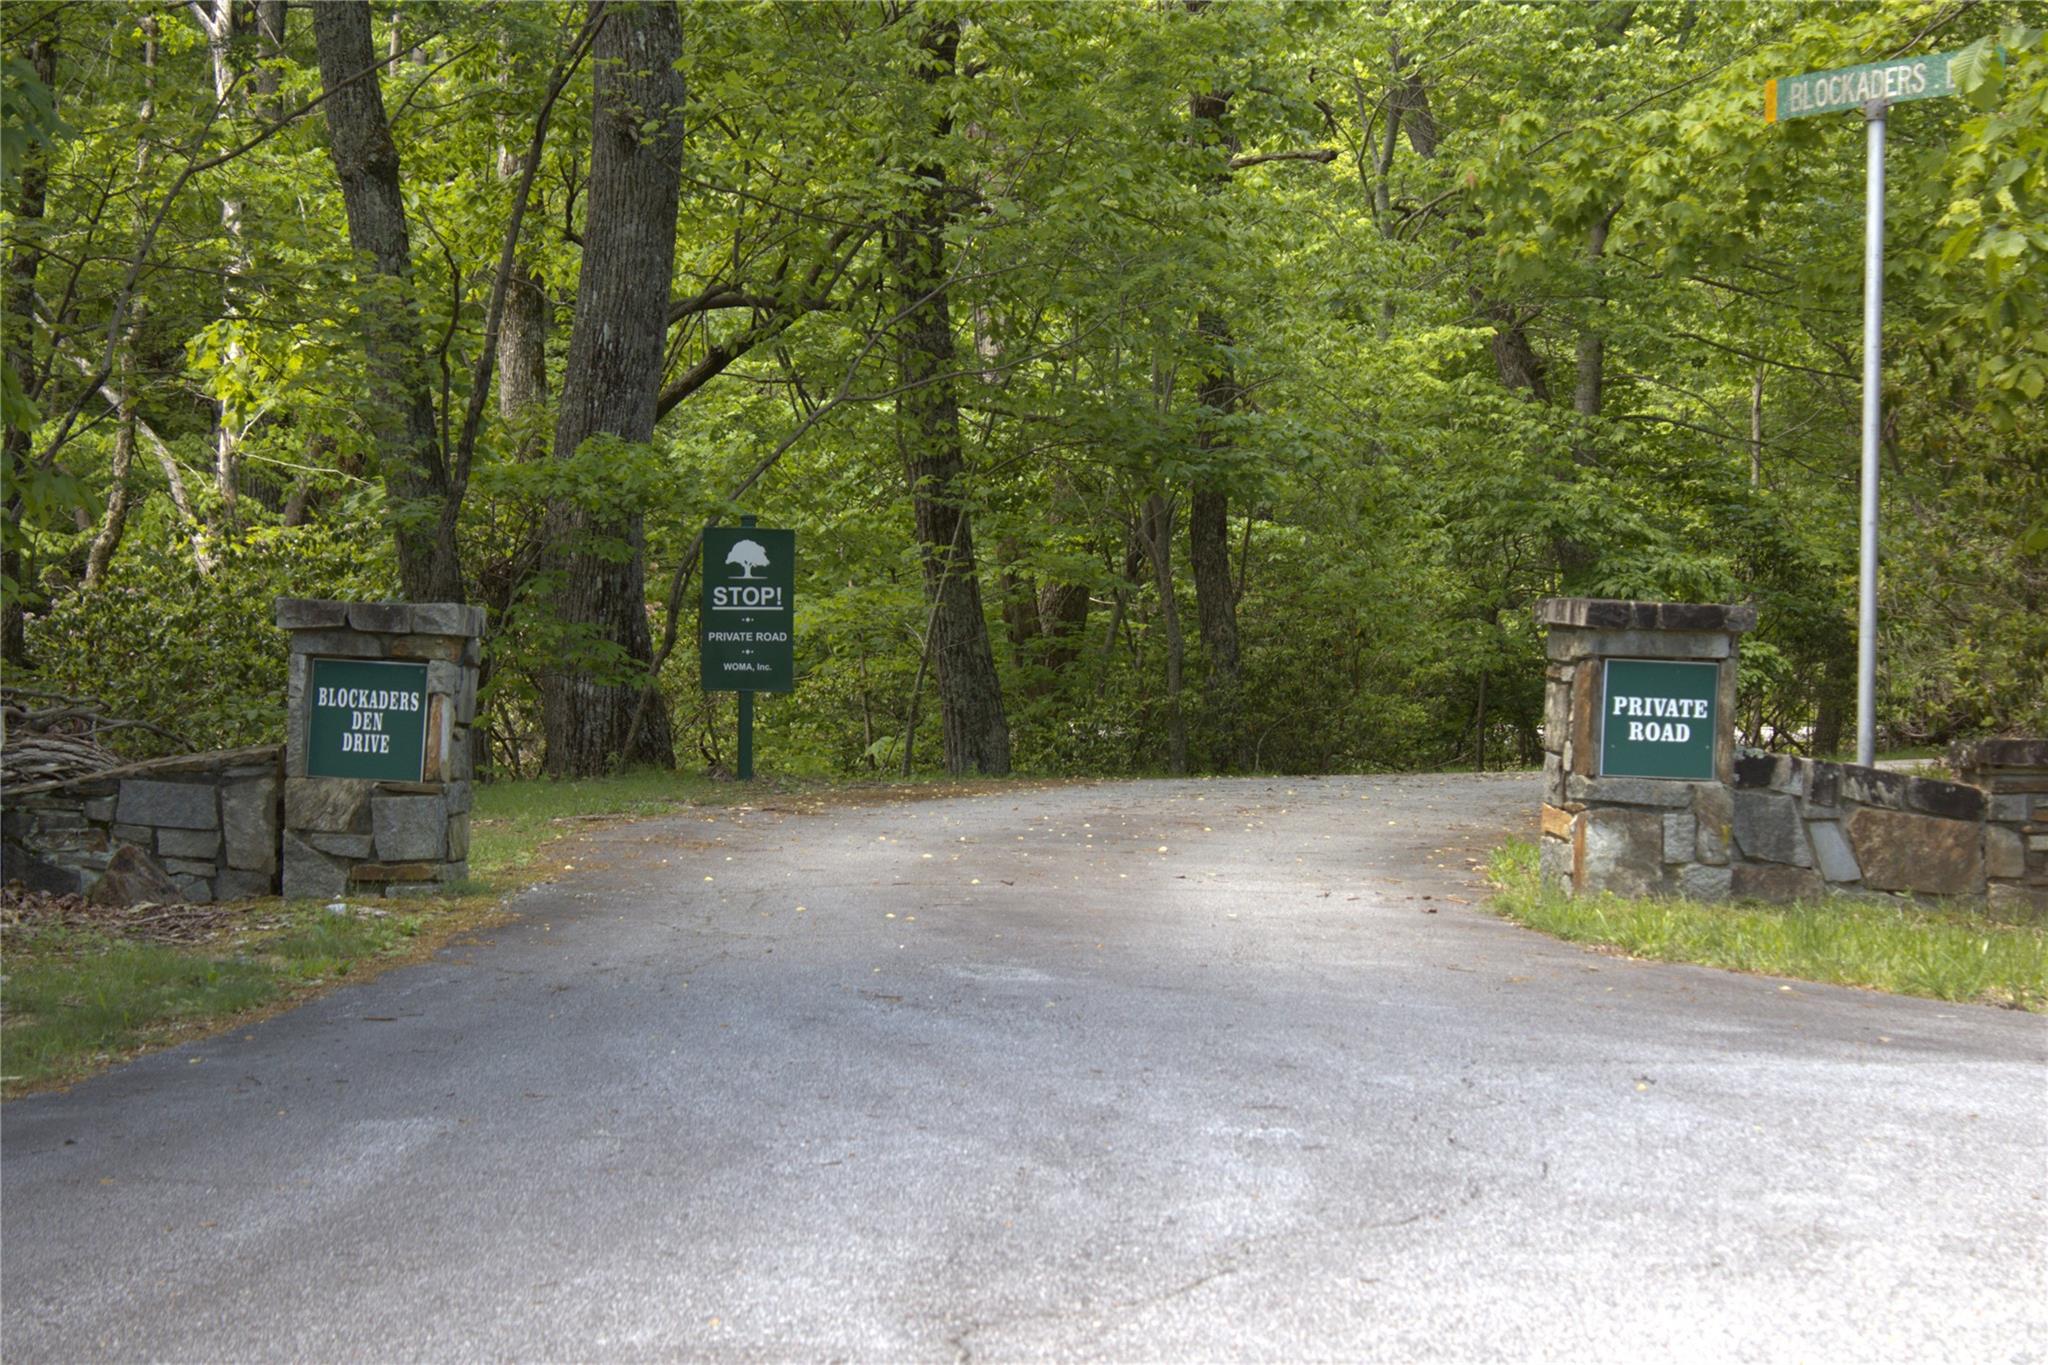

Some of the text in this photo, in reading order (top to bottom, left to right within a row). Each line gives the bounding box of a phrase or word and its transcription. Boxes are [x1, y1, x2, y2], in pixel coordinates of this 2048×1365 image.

[1790, 62, 1926, 112] BLOCKADERS
[713, 586, 782, 606] STOP!
[708, 631, 787, 642] PRIVATE ROAD
[723, 662, 772, 672] WOMA, Inc.
[318, 687, 420, 712] BLOCKADERS
[1612, 695, 1709, 719] PRIVATE
[351, 711, 384, 732] DEN
[1628, 721, 1691, 743] ROAD
[341, 732, 390, 754] DRIVE
